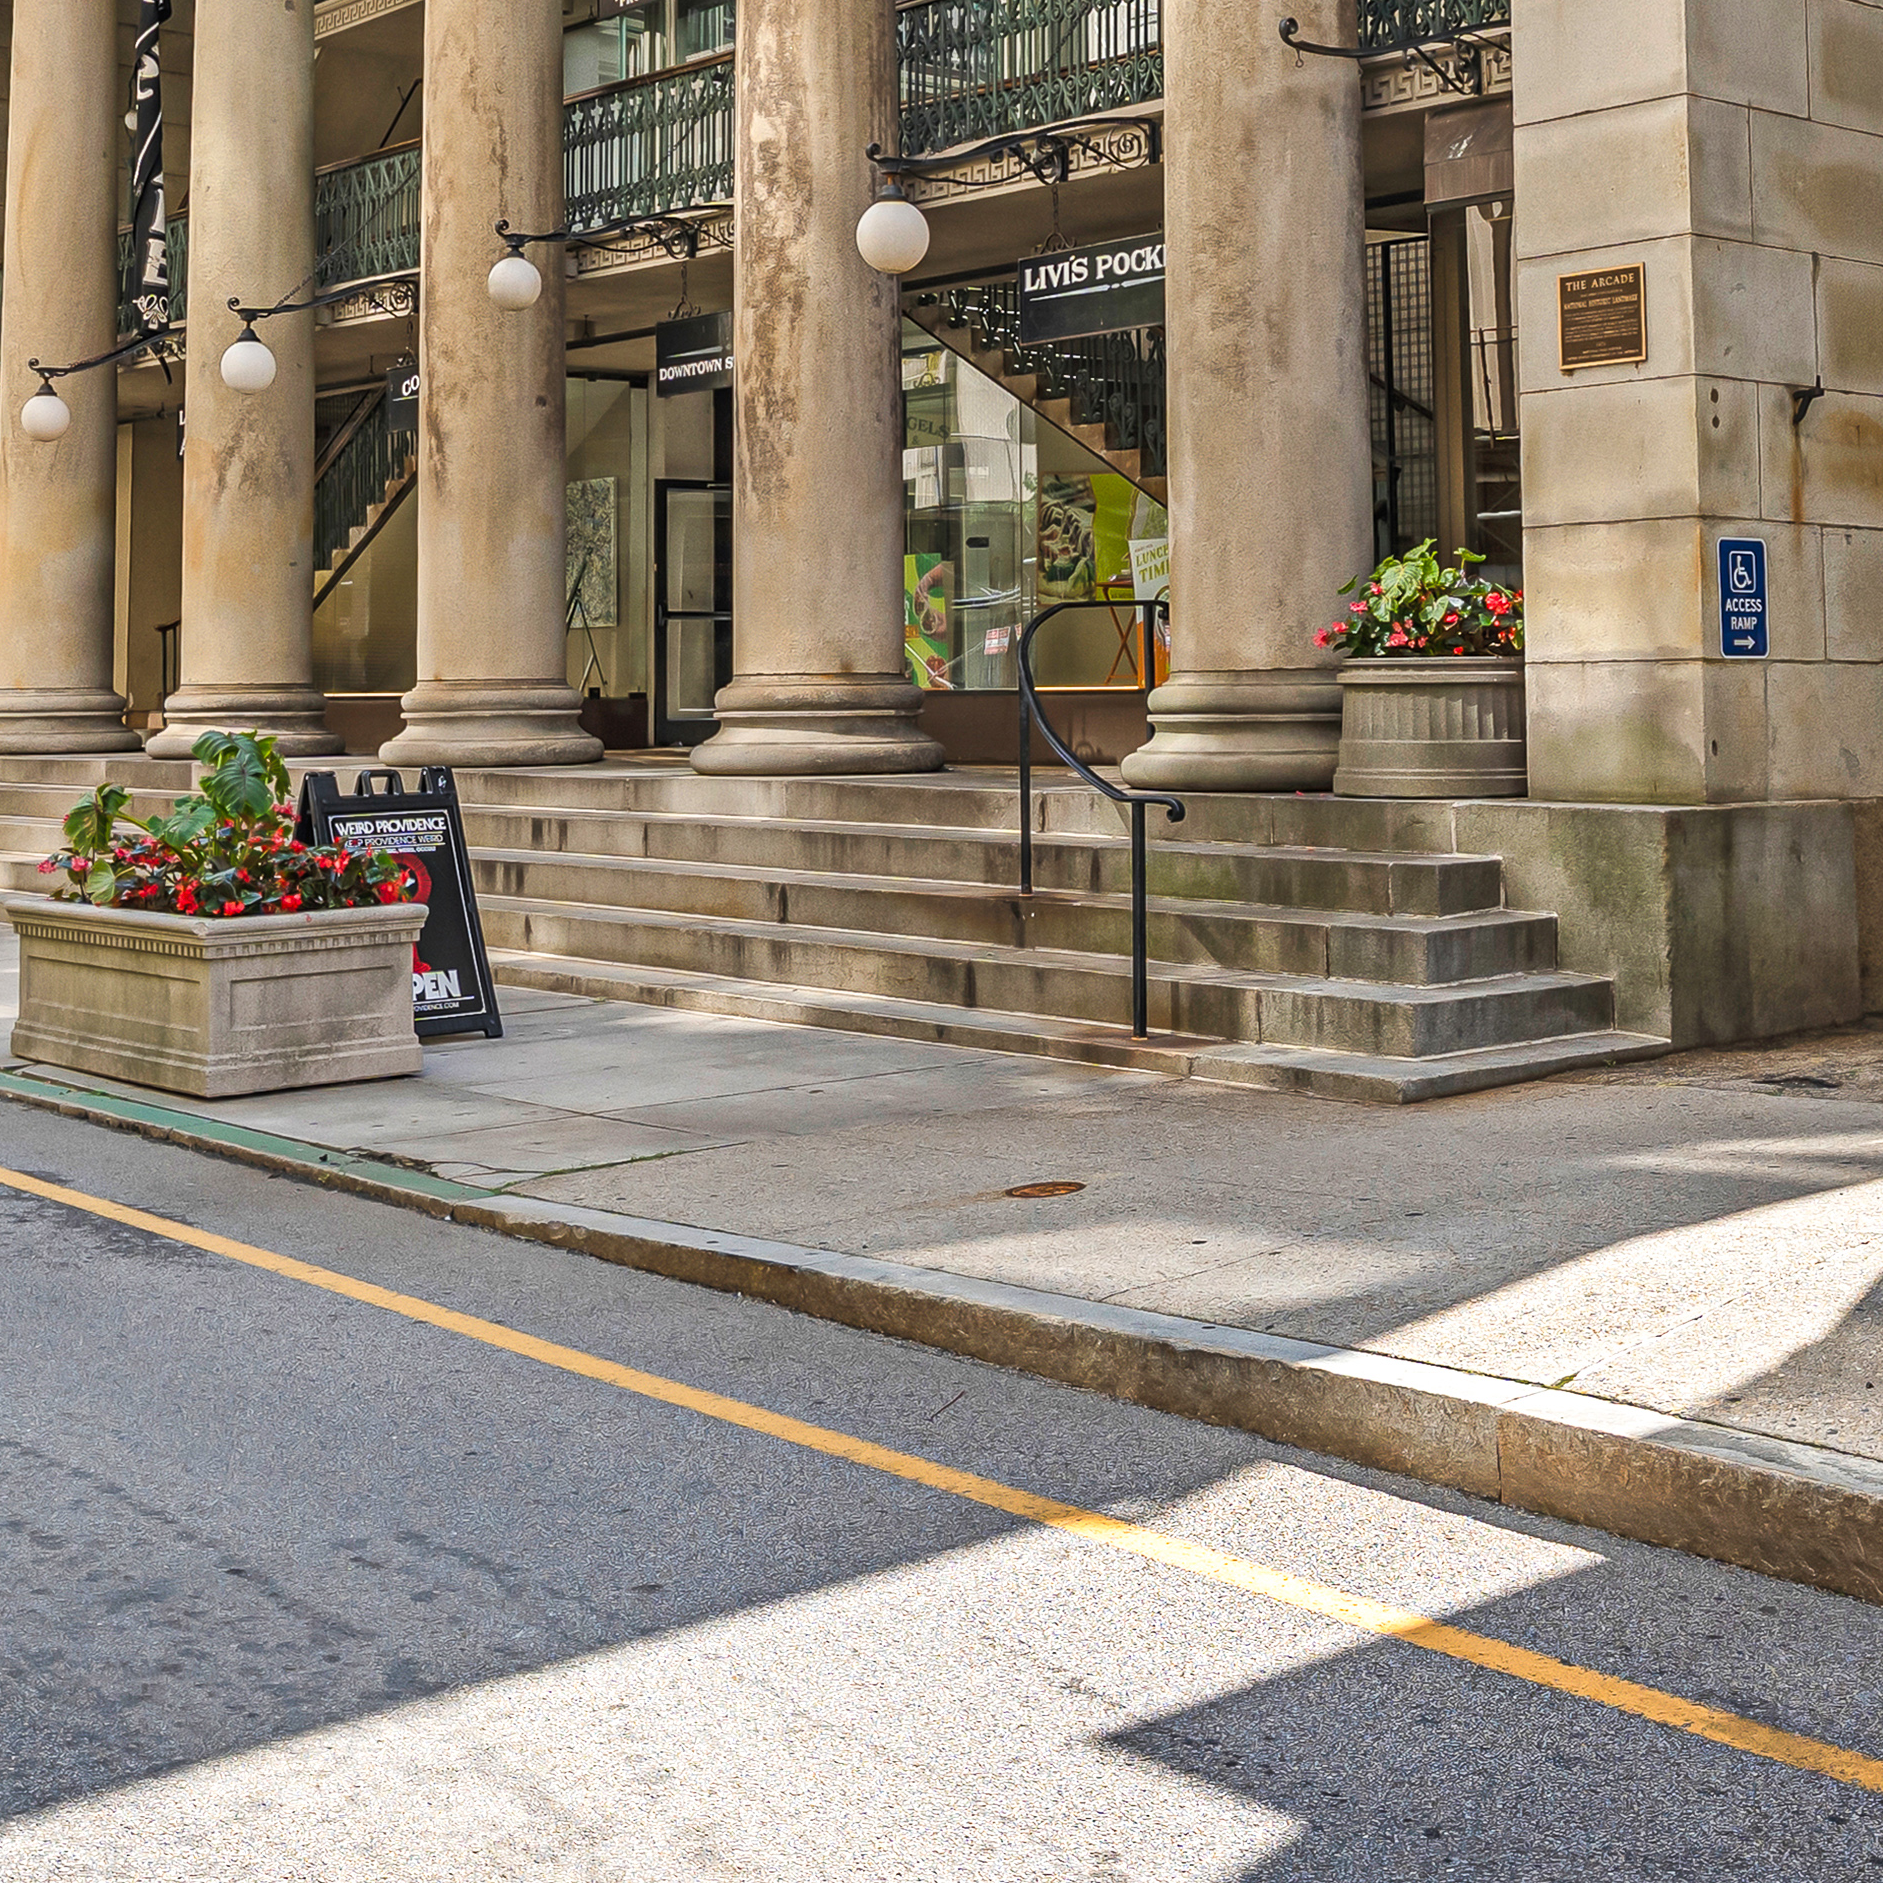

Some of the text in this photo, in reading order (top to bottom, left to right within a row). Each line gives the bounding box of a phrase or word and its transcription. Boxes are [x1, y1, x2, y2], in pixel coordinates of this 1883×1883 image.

[1095, 244, 1166, 280] POCK
[1565, 272, 1635, 292] THE ARCADE
[659, 358, 722, 381] DOWNTOWN
[1725, 598, 1763, 612] ACCESS
[1731, 616, 1757, 630] RAMP
[335, 817, 447, 837] WEIRD PROVIDENCE
[364, 835, 416, 847] PROVIDENCE
[412, 969, 461, 1001] PEN
